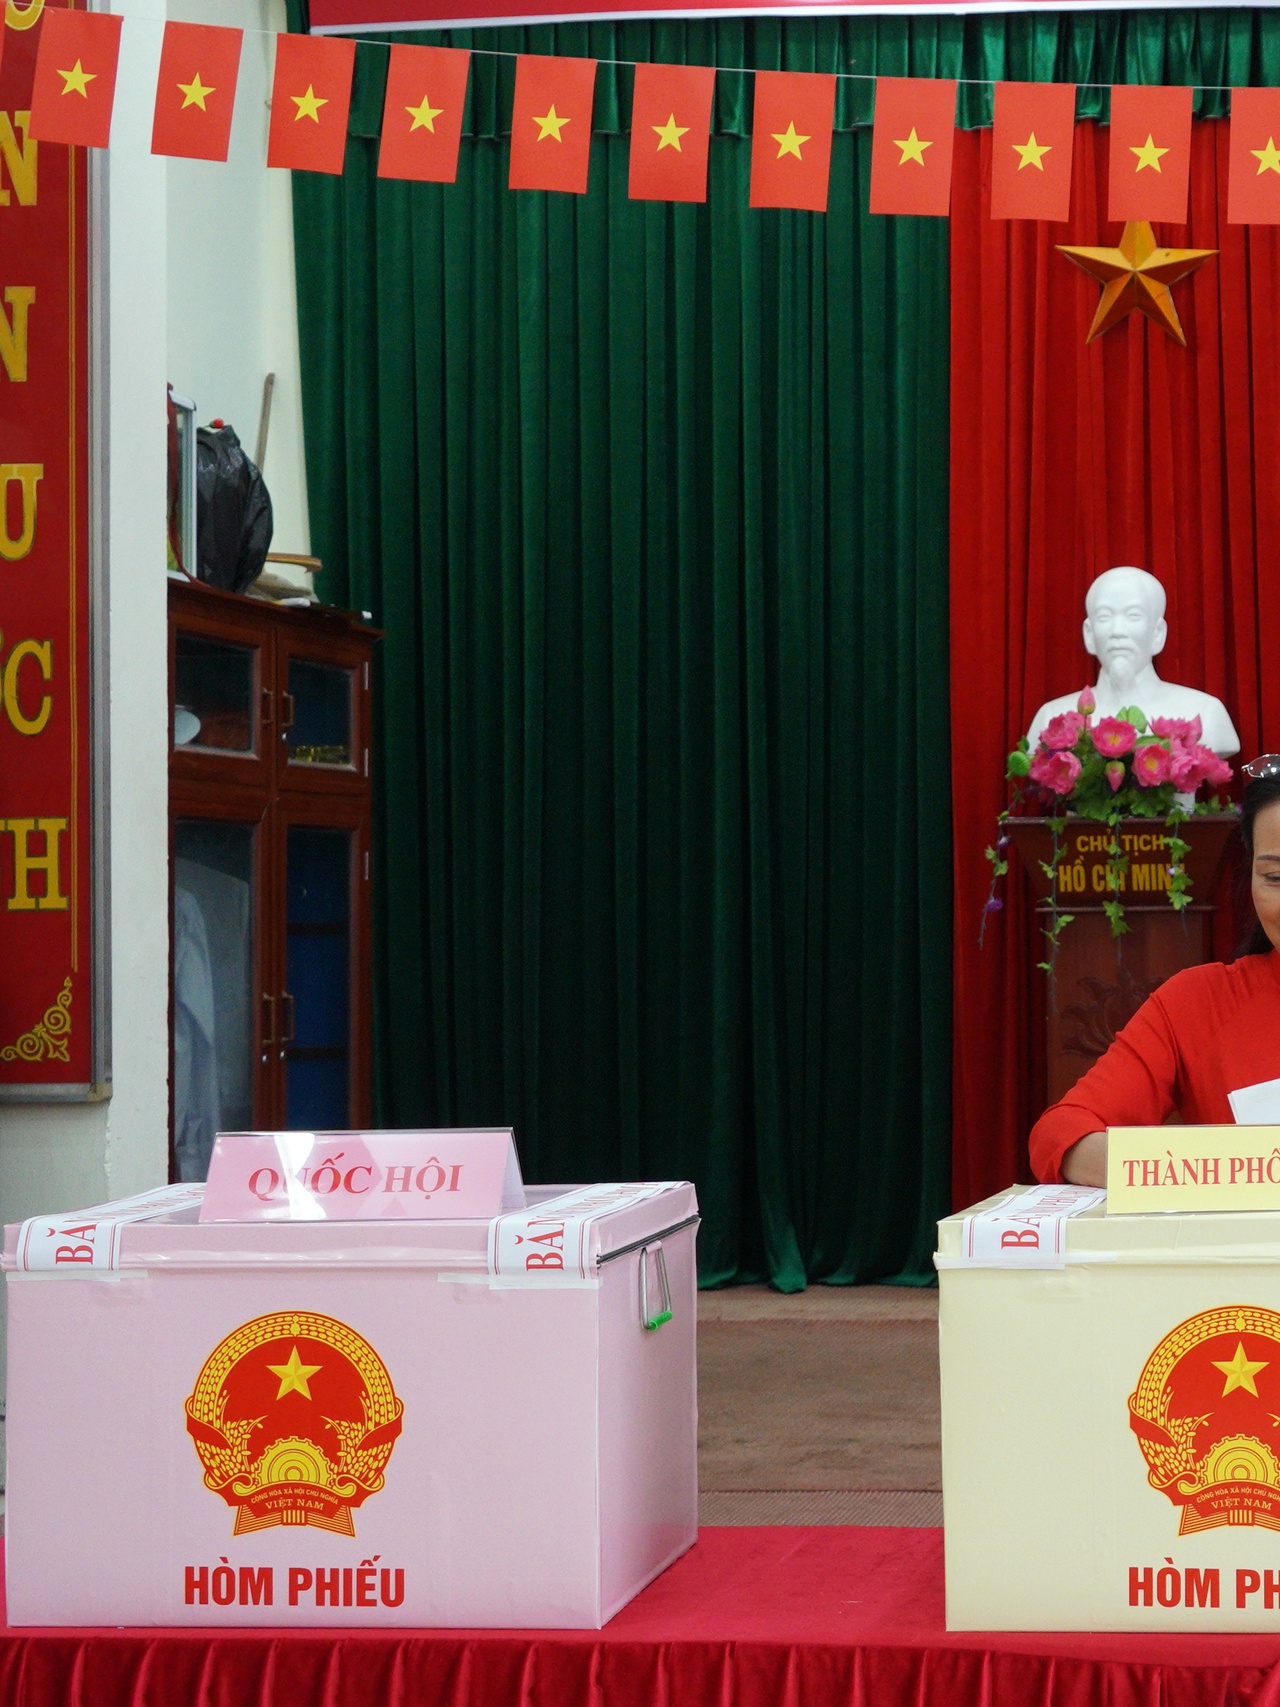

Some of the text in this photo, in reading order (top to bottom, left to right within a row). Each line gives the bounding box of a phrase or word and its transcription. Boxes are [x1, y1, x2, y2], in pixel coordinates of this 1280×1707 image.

[1121, 834, 1165, 857] TỊCH
[1058, 855, 1087, 893] HỒ
[1131, 863, 1186, 892] MIN
[381, 1155, 465, 1200] HỘI
[1122, 1149, 1222, 1187] THÀNH
[265, 1497, 325, 1510] VIỆT NAM
[1210, 1497, 1273, 1510] VIỆT NAM
[182, 1554, 407, 1609] HÒM PHIẾU
[1127, 1557, 1222, 1609] HÒM
